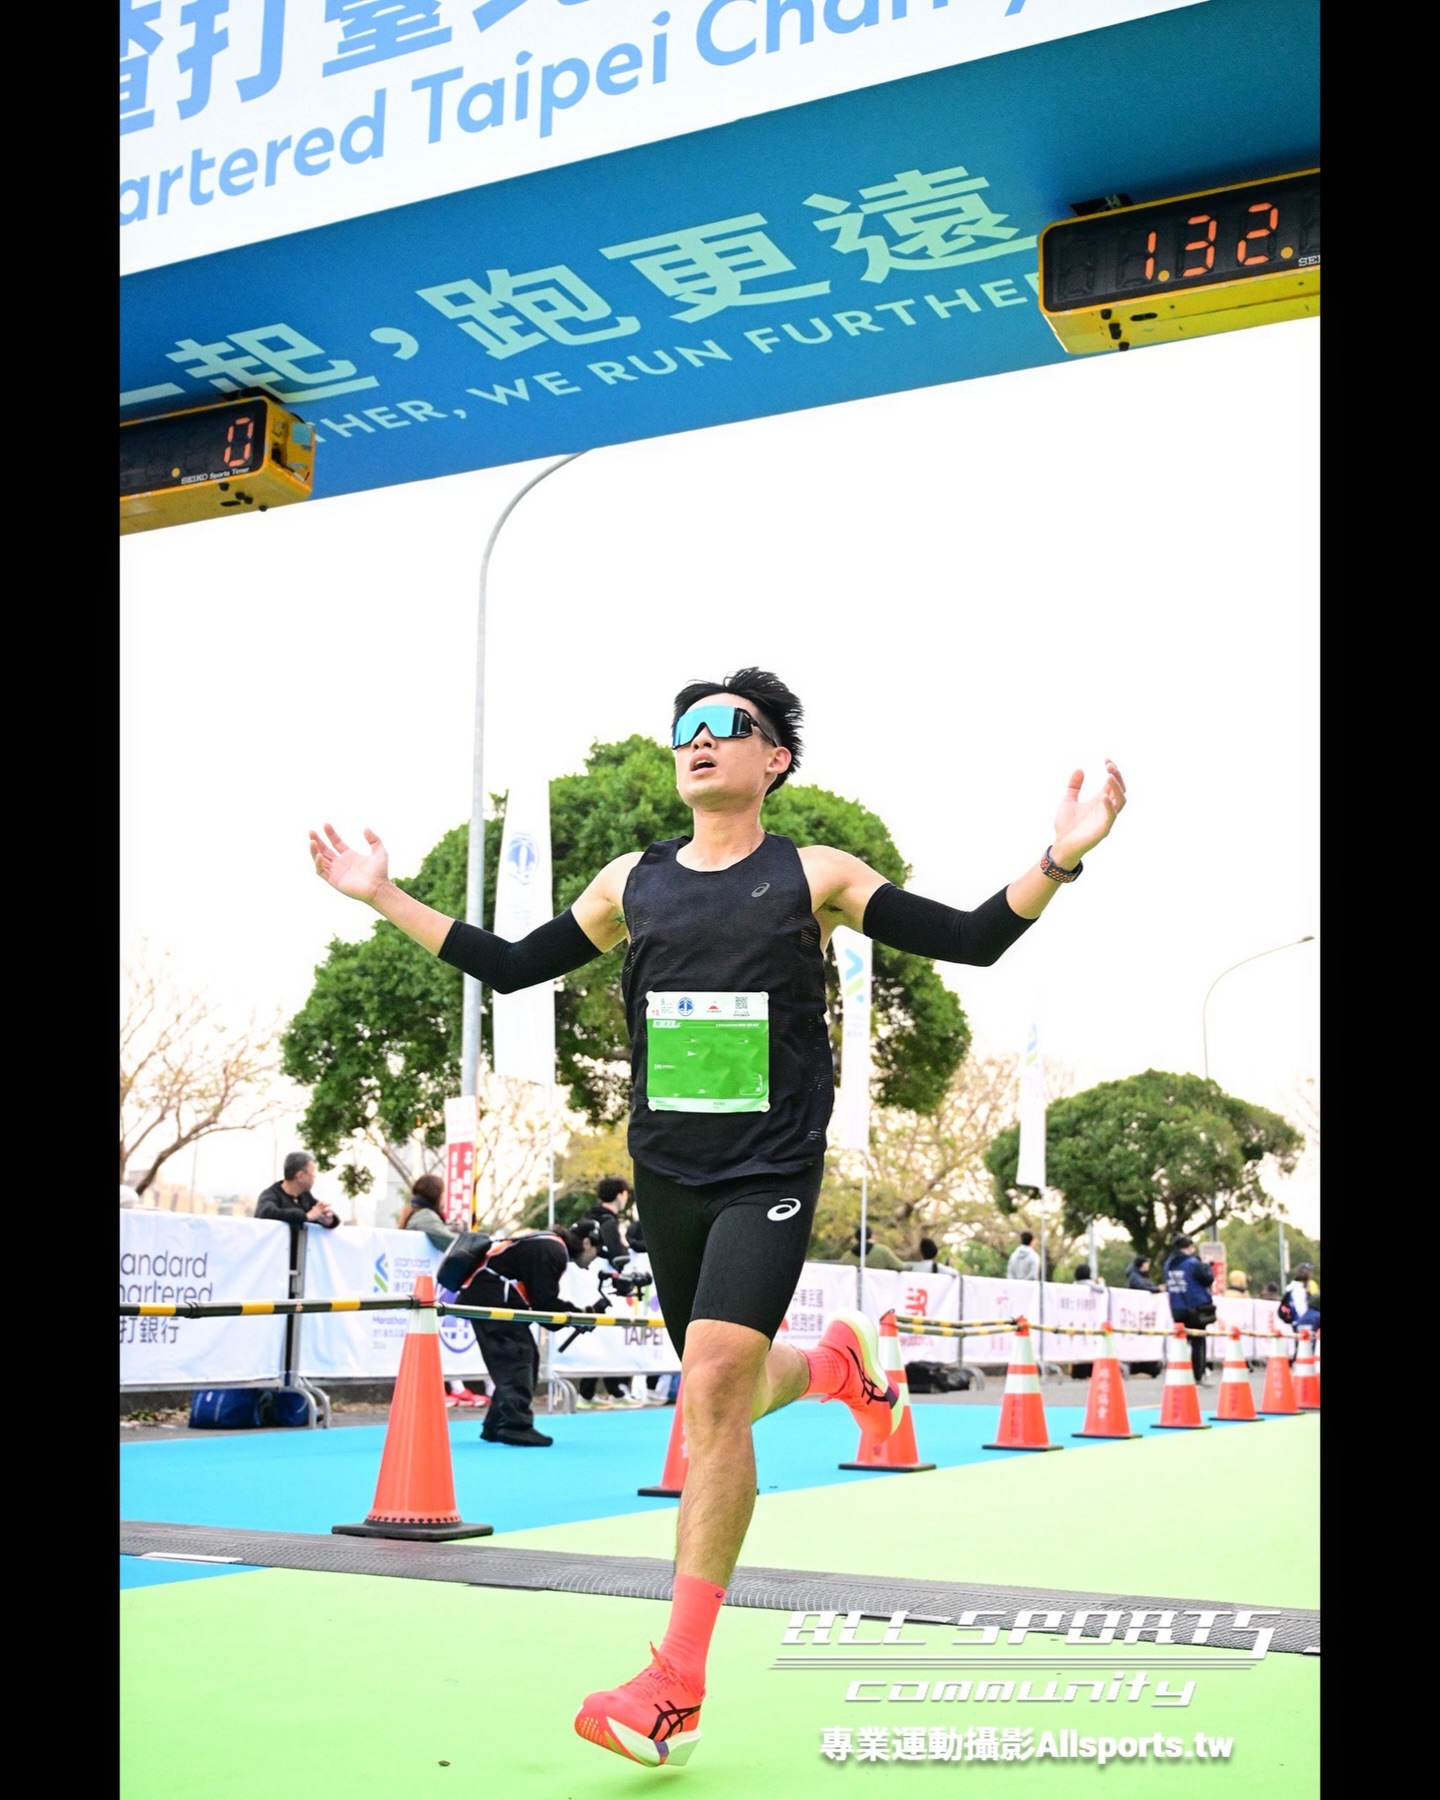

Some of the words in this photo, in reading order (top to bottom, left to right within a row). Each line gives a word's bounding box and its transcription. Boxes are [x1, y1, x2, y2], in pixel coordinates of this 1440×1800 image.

[411, 10, 671, 139] Taipei
[306, 400, 467, 443] HER,
[466, 371, 582, 406] WE
[587, 339, 733, 385] RUN
[743, 272, 1039, 354] FURTHE
[224, 416, 254, 467] 0
[181, 473, 208, 485] SEIKO
[209, 470, 230, 480] Sports
[120, 1250, 208, 1278] andard
